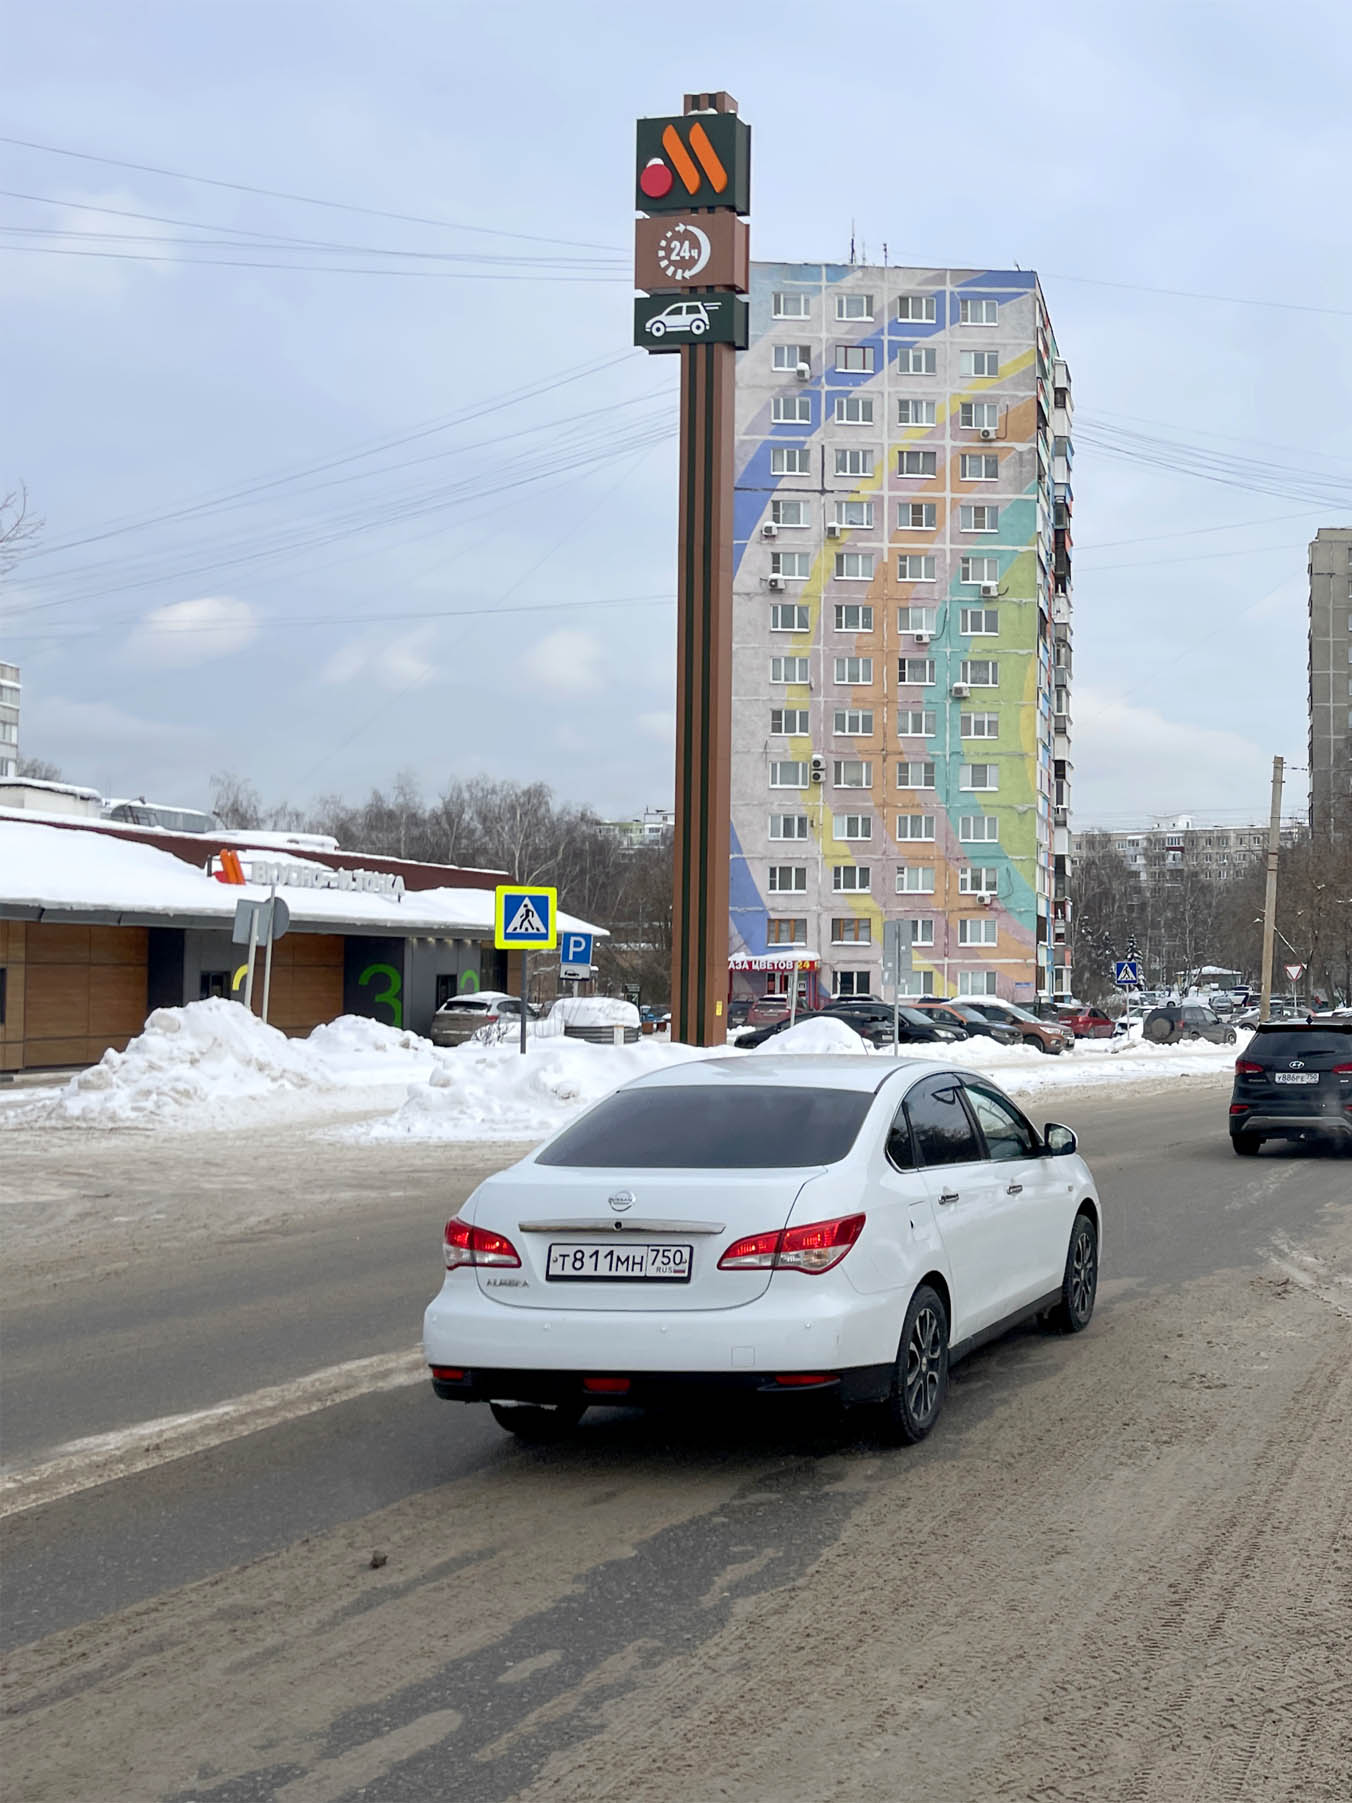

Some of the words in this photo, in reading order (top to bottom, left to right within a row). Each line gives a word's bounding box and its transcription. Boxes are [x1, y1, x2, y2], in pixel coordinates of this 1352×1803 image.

[671, 240, 698, 260] 24ч
[728, 960, 749, 970] АЗА
[751, 960, 793, 971] ЦВЕТОВ
[559, 1250, 644, 1272] Т811МН
[650, 1249, 684, 1266] 750
